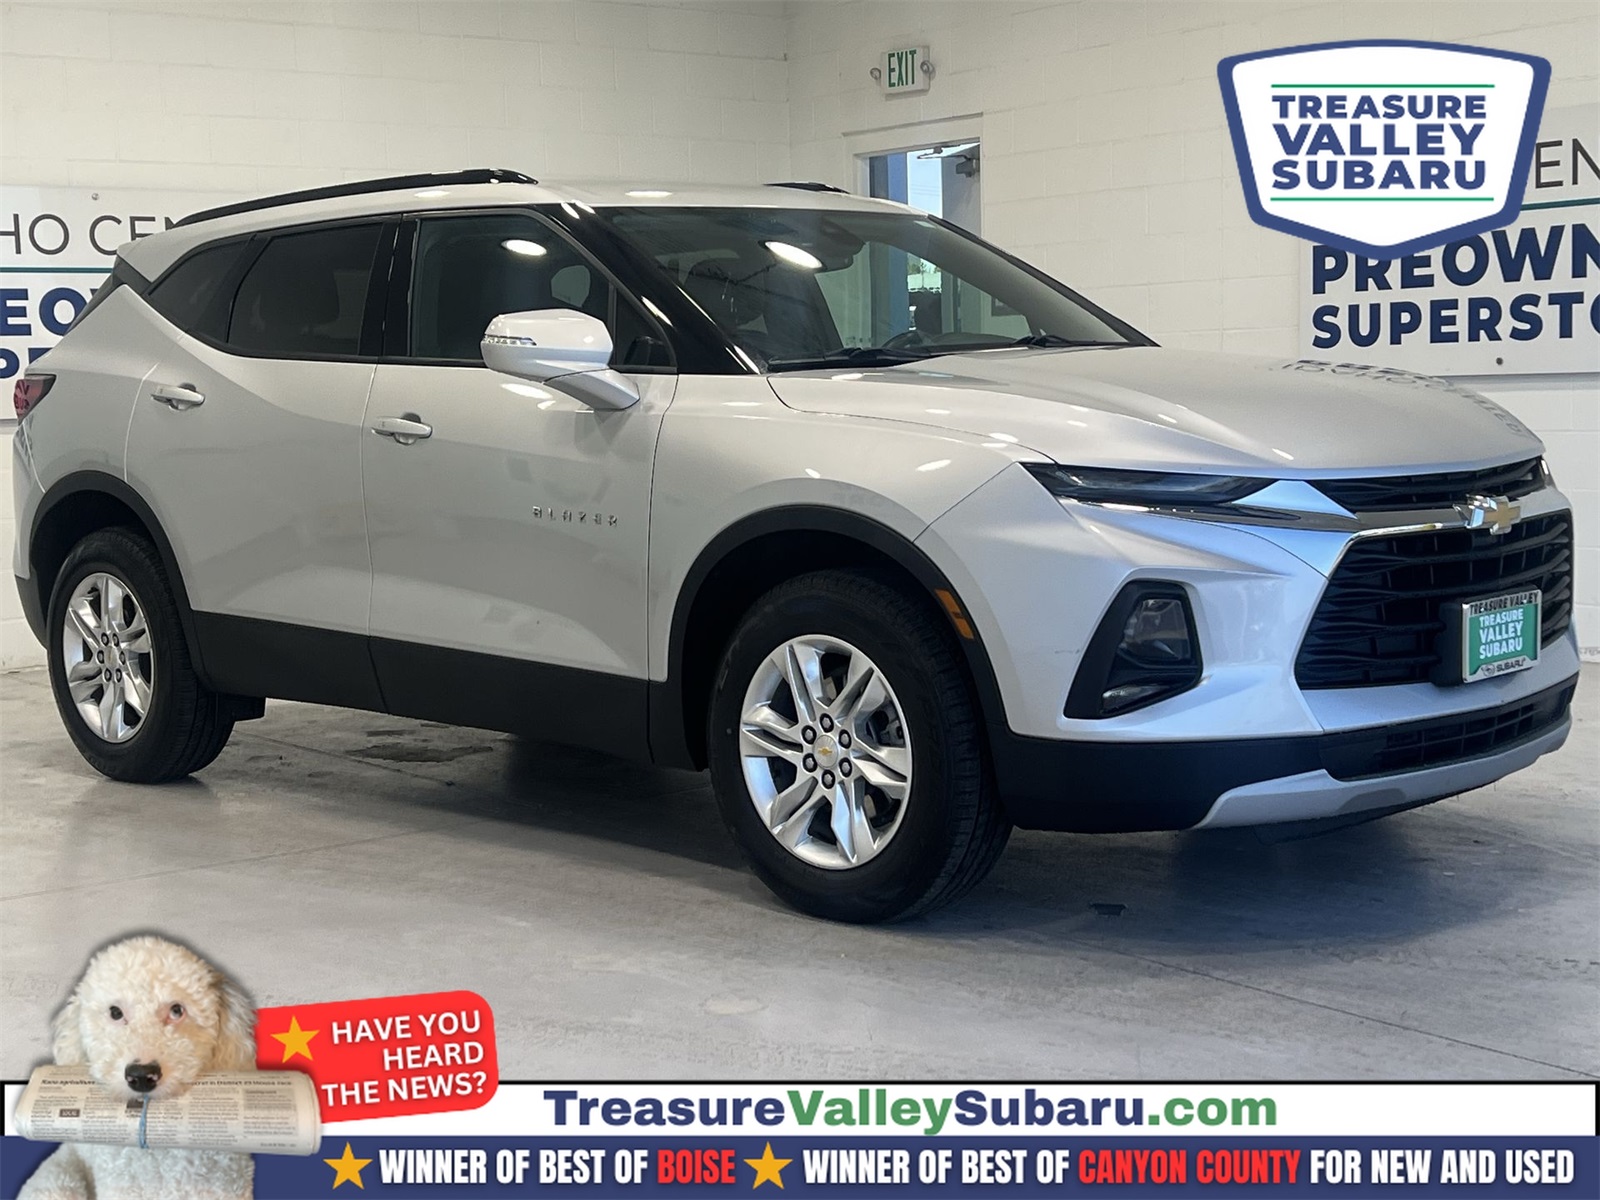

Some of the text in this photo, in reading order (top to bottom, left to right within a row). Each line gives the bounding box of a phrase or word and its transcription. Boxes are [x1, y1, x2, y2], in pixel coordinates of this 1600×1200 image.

[887, 49, 917, 88] EXIT
[1311, 291, 1600, 350] SUPERST
[532, 505, 618, 527] BLAZER
[1470, 592, 1539, 615] TREASURE VALLEY
[1479, 608, 1524, 628] TREASURE
[1479, 620, 1524, 644] VALLEY
[1479, 636, 1523, 660] SUBARU
[1496, 658, 1525, 673] SUBARU
